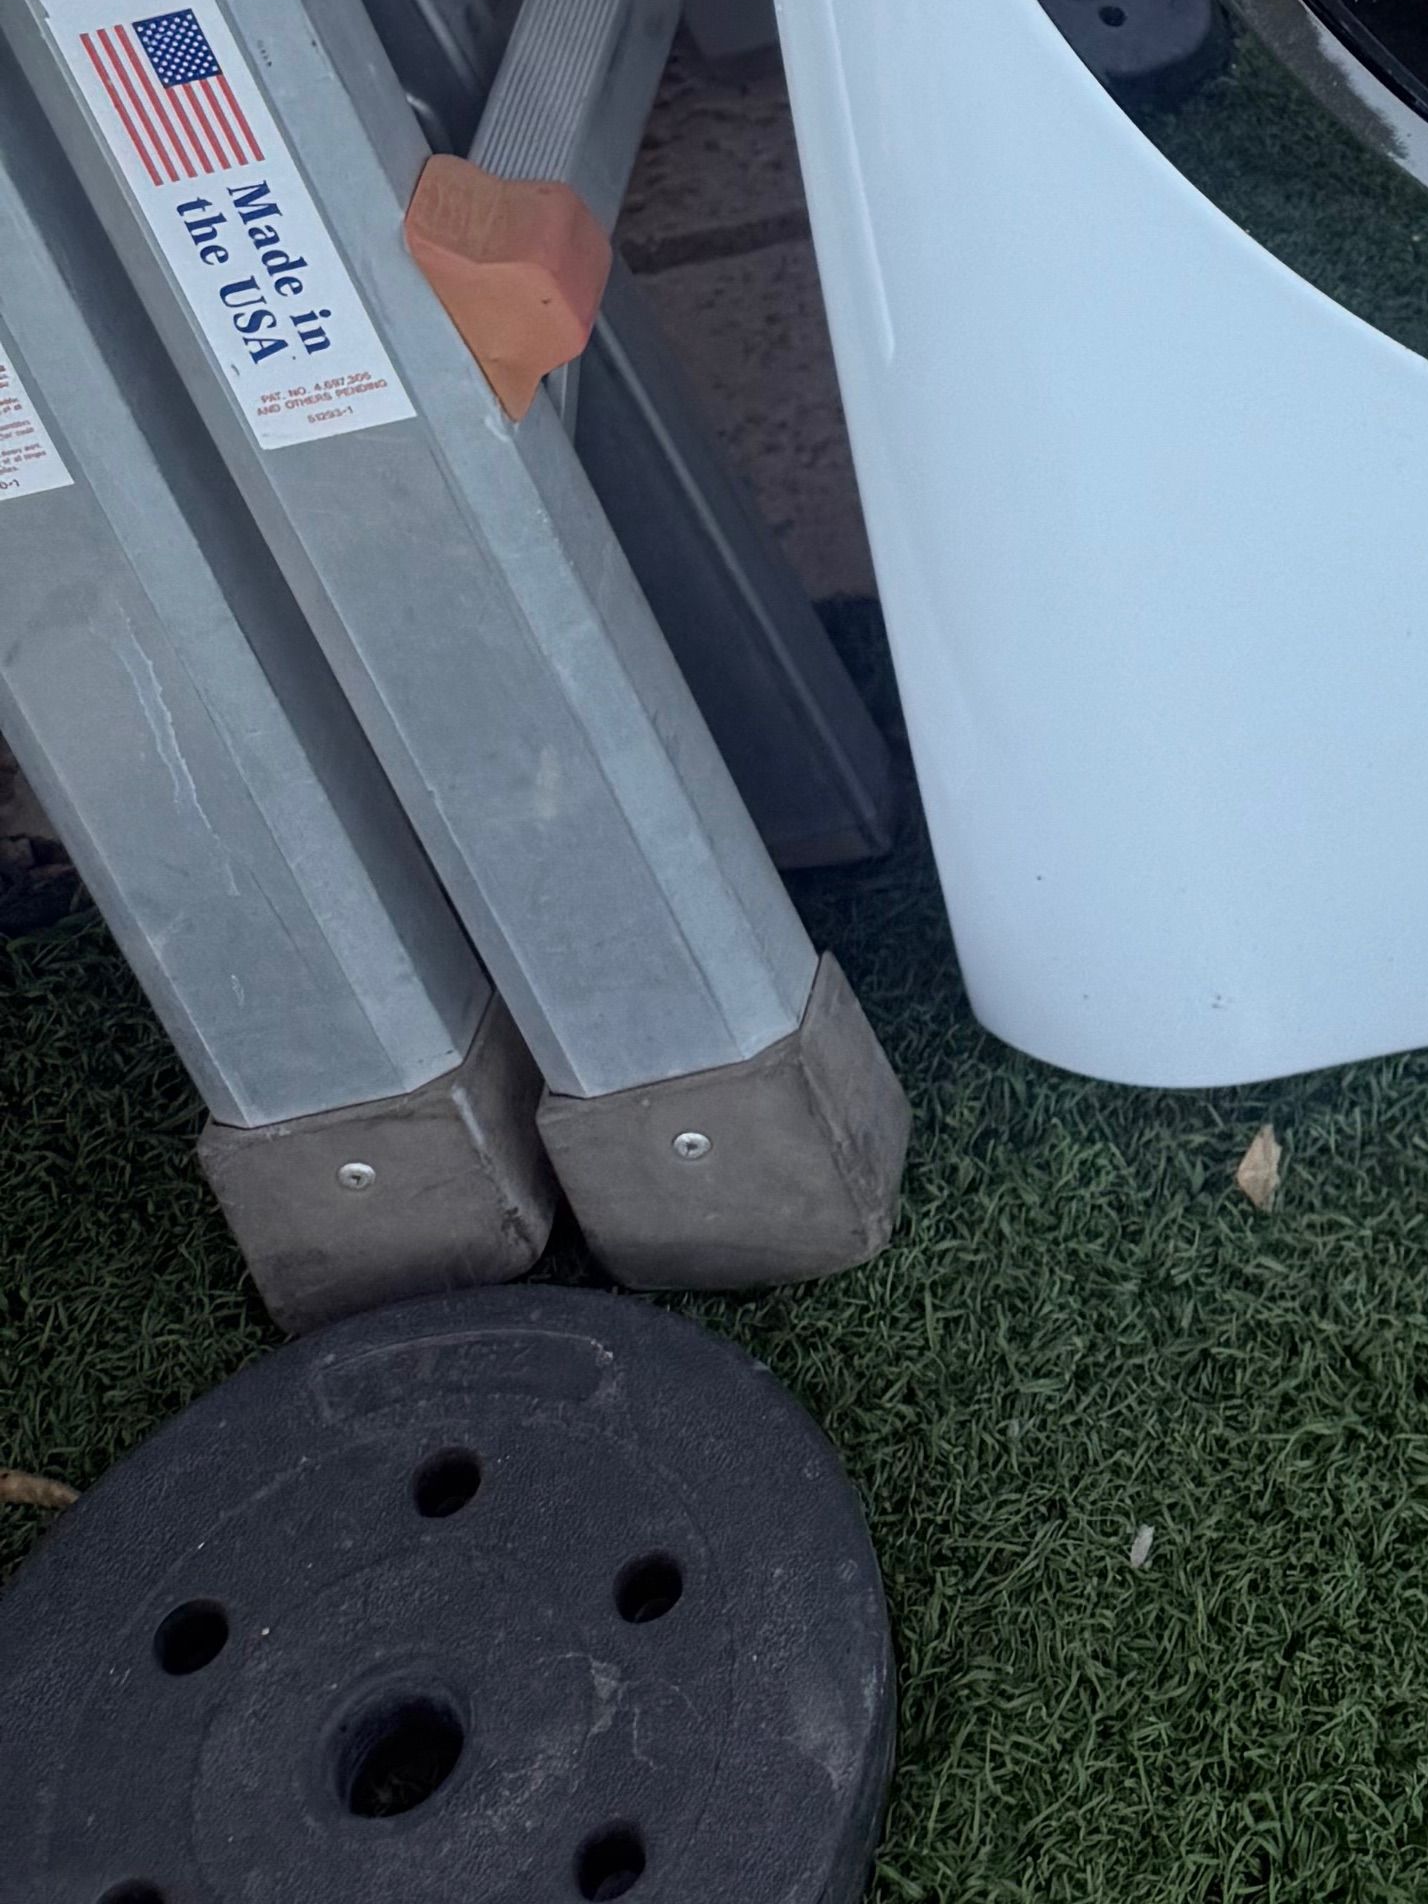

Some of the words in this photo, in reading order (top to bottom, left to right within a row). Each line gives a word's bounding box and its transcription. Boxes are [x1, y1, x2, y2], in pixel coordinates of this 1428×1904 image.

[176, 197, 229, 266] the
[219, 275, 289, 364] USA
[226, 180, 308, 296] Made
[289, 309, 332, 355] in
[257, 404, 281, 416] AND
[285, 393, 332, 409] OTHERS
[336, 379, 388, 399] PENDING
